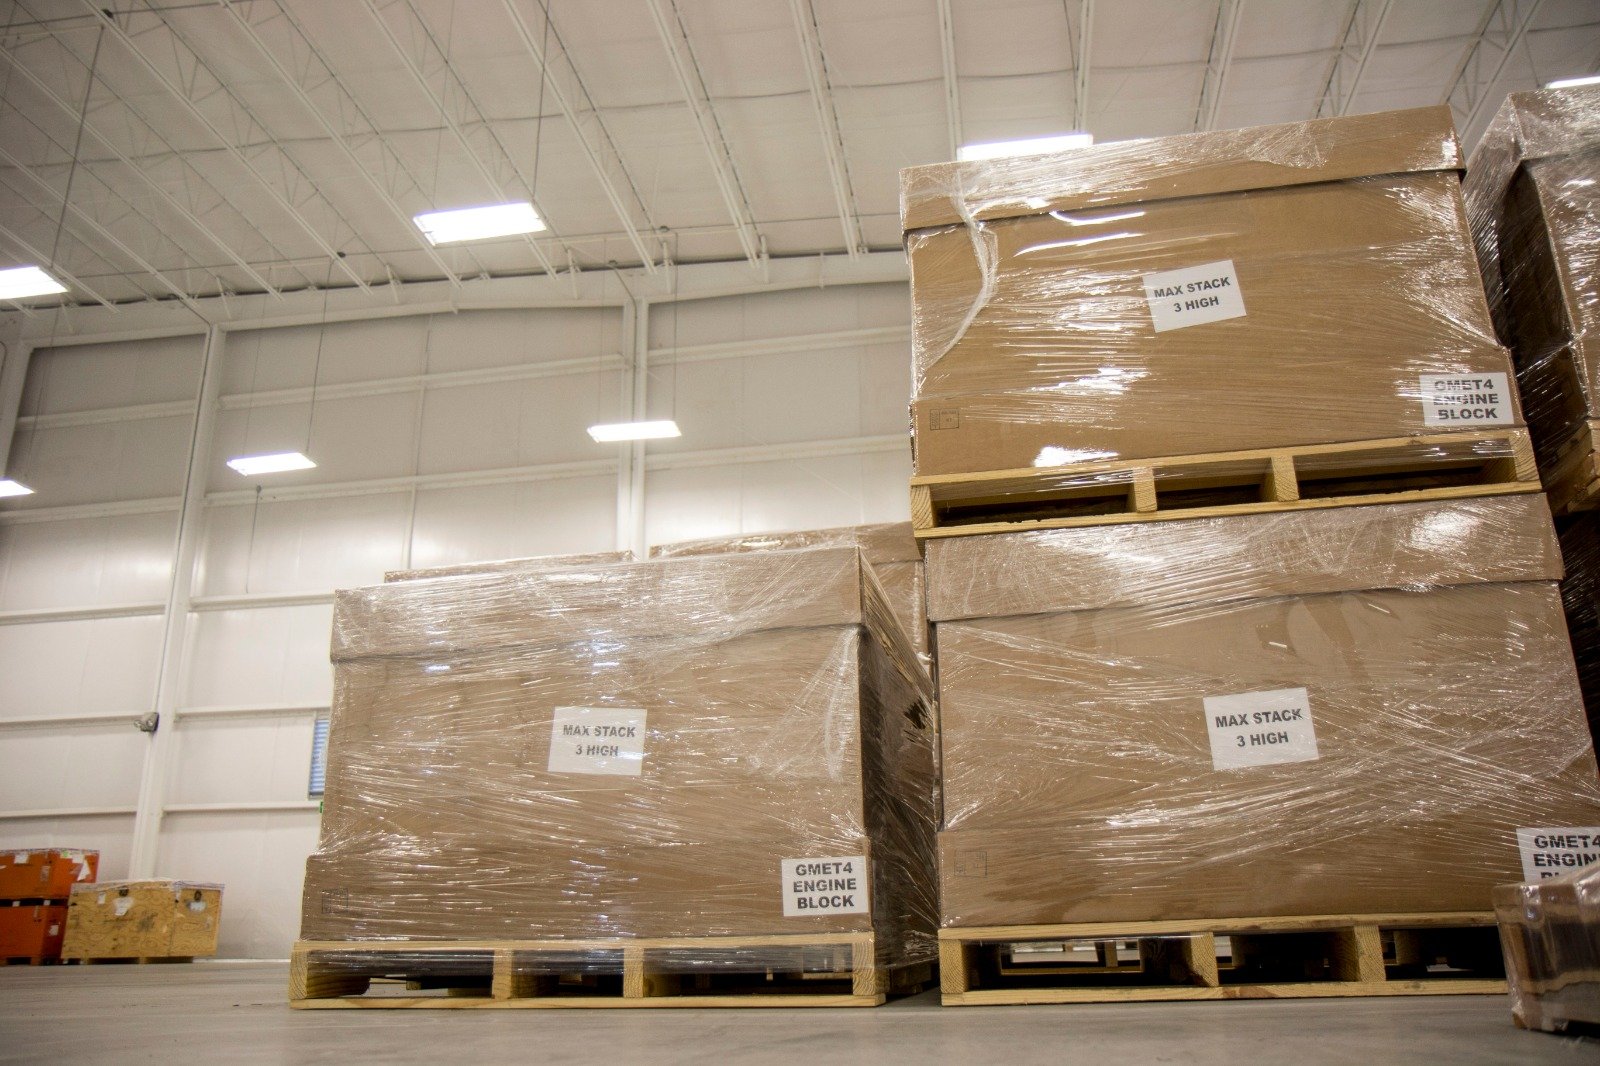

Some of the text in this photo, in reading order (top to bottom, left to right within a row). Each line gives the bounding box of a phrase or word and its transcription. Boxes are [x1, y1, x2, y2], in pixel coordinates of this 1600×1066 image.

[1154, 276, 1231, 298] MAX STACK
[1173, 295, 1220, 312] 3 HIGH
[1438, 407, 1498, 420] BLOCK
[1215, 708, 1304, 728] MAX STACK
[563, 724, 636, 738] MAX STACK
[1236, 731, 1289, 748] 3 HIGH
[575, 744, 619, 757] 3 HIGH
[1533, 853, 1600, 867] ENGIN
[795, 861, 853, 876] GMET4
[793, 878, 857, 893] ENGINE
[797, 894, 855, 910] BLOCK
